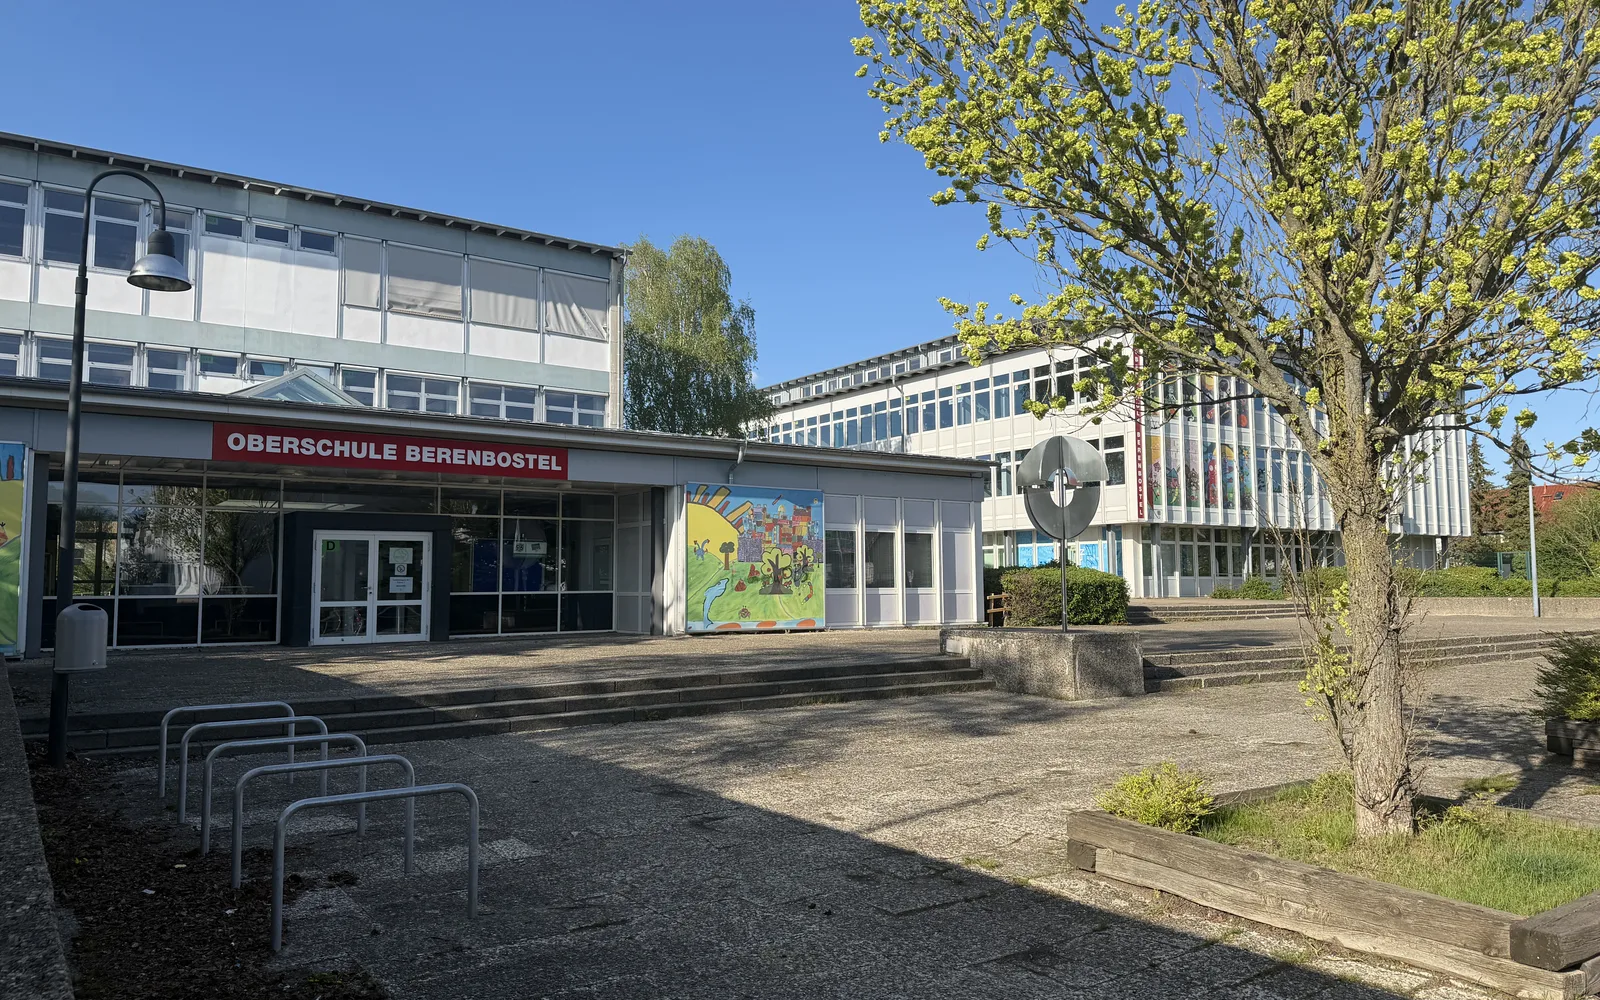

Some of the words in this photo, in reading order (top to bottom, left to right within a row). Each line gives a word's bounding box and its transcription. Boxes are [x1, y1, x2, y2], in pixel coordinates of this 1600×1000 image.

[226, 431, 398, 461] OBERSCHULE
[405, 444, 562, 471] BERENBOSTEL
[326, 541, 335, 550] D
